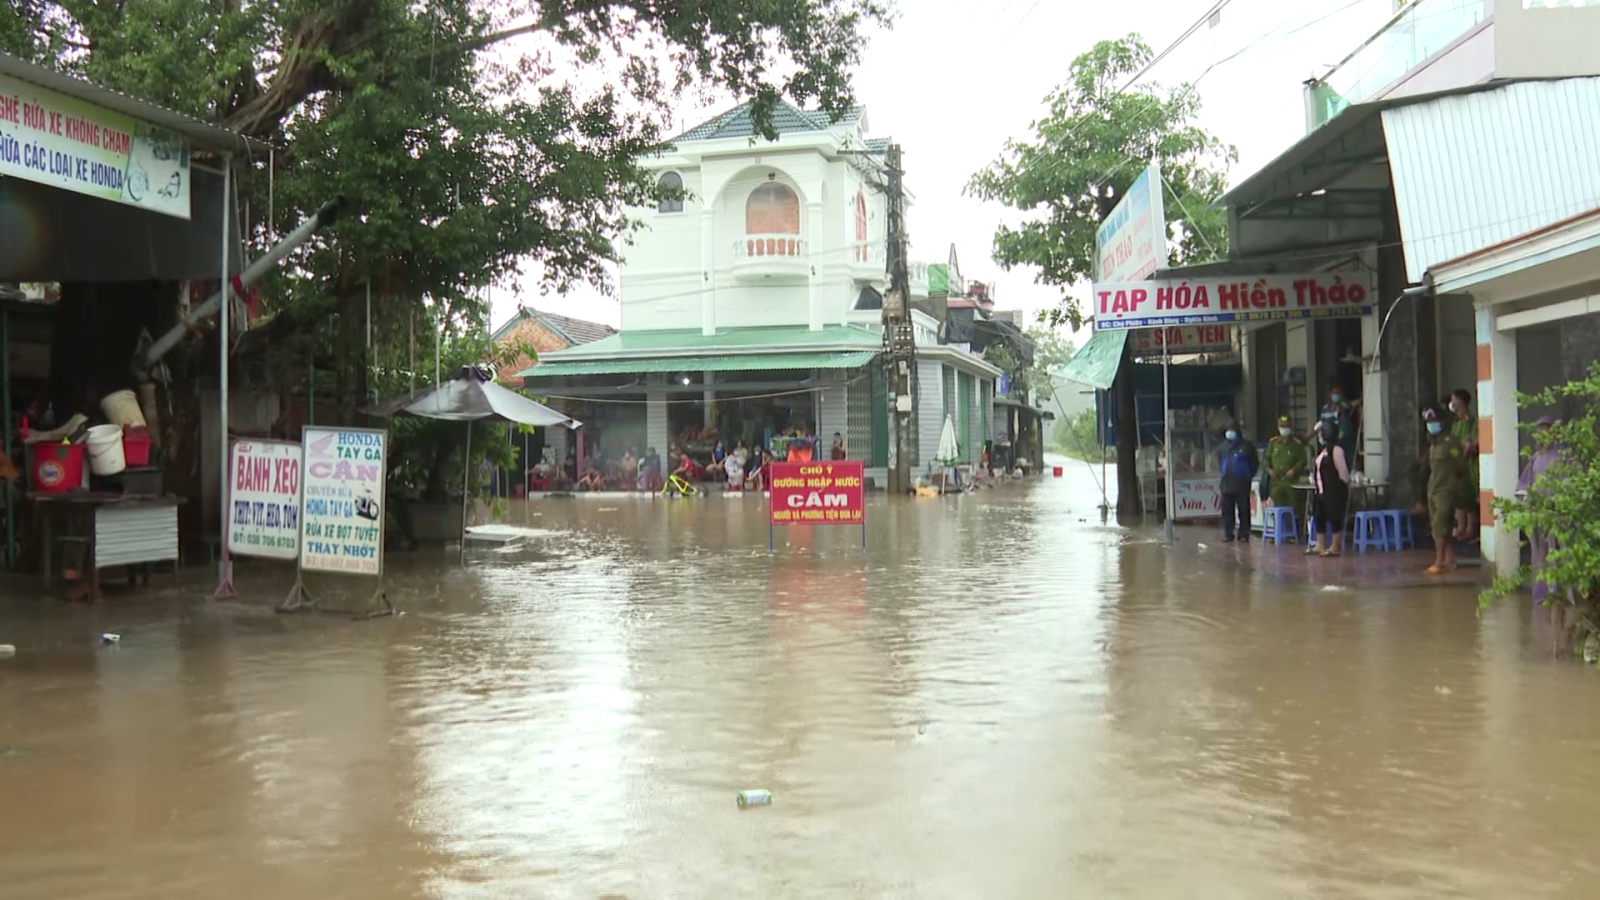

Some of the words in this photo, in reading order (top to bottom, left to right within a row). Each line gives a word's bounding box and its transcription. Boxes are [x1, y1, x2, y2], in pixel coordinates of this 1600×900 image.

[24, 98, 46, 132] RỬA
[50, 111, 63, 136] XE
[66, 115, 100, 147] KHÔNG
[103, 127, 131, 158] CHẠM
[24, 140, 47, 171] CÁC
[50, 151, 73, 182] LOẠI
[76, 157, 88, 181] XE
[91, 163, 123, 191] HONDA
[1097, 288, 1148, 318] TẠP
[1156, 281, 1210, 310] HÓA
[1217, 278, 1287, 310] Hiền
[1293, 275, 1366, 307] Thảo
[338, 432, 382, 447] HONDA
[337, 446, 361, 459] TAY
[364, 448, 382, 461] GA
[236, 445, 271, 493] BÁNH
[273, 447, 299, 496] XÈO
[800, 464, 823, 475] CHÚ
[826, 463, 834, 475] Ý
[773, 476, 806, 488] ĐƯỜNG
[807, 475, 833, 489] NGẬP
[834, 475, 860, 488] NƯỚC
[787, 487, 848, 508] CẤM
[306, 498, 328, 516] HONDA
[329, 499, 343, 517] TAY
[344, 500, 353, 518] GA
[839, 509, 851, 520] QUA
[305, 516, 322, 537] RỬA
[324, 524, 335, 539] XE
[337, 525, 353, 543] BỌT
[307, 540, 340, 555] THAY
[342, 542, 376, 558] NHỚT
